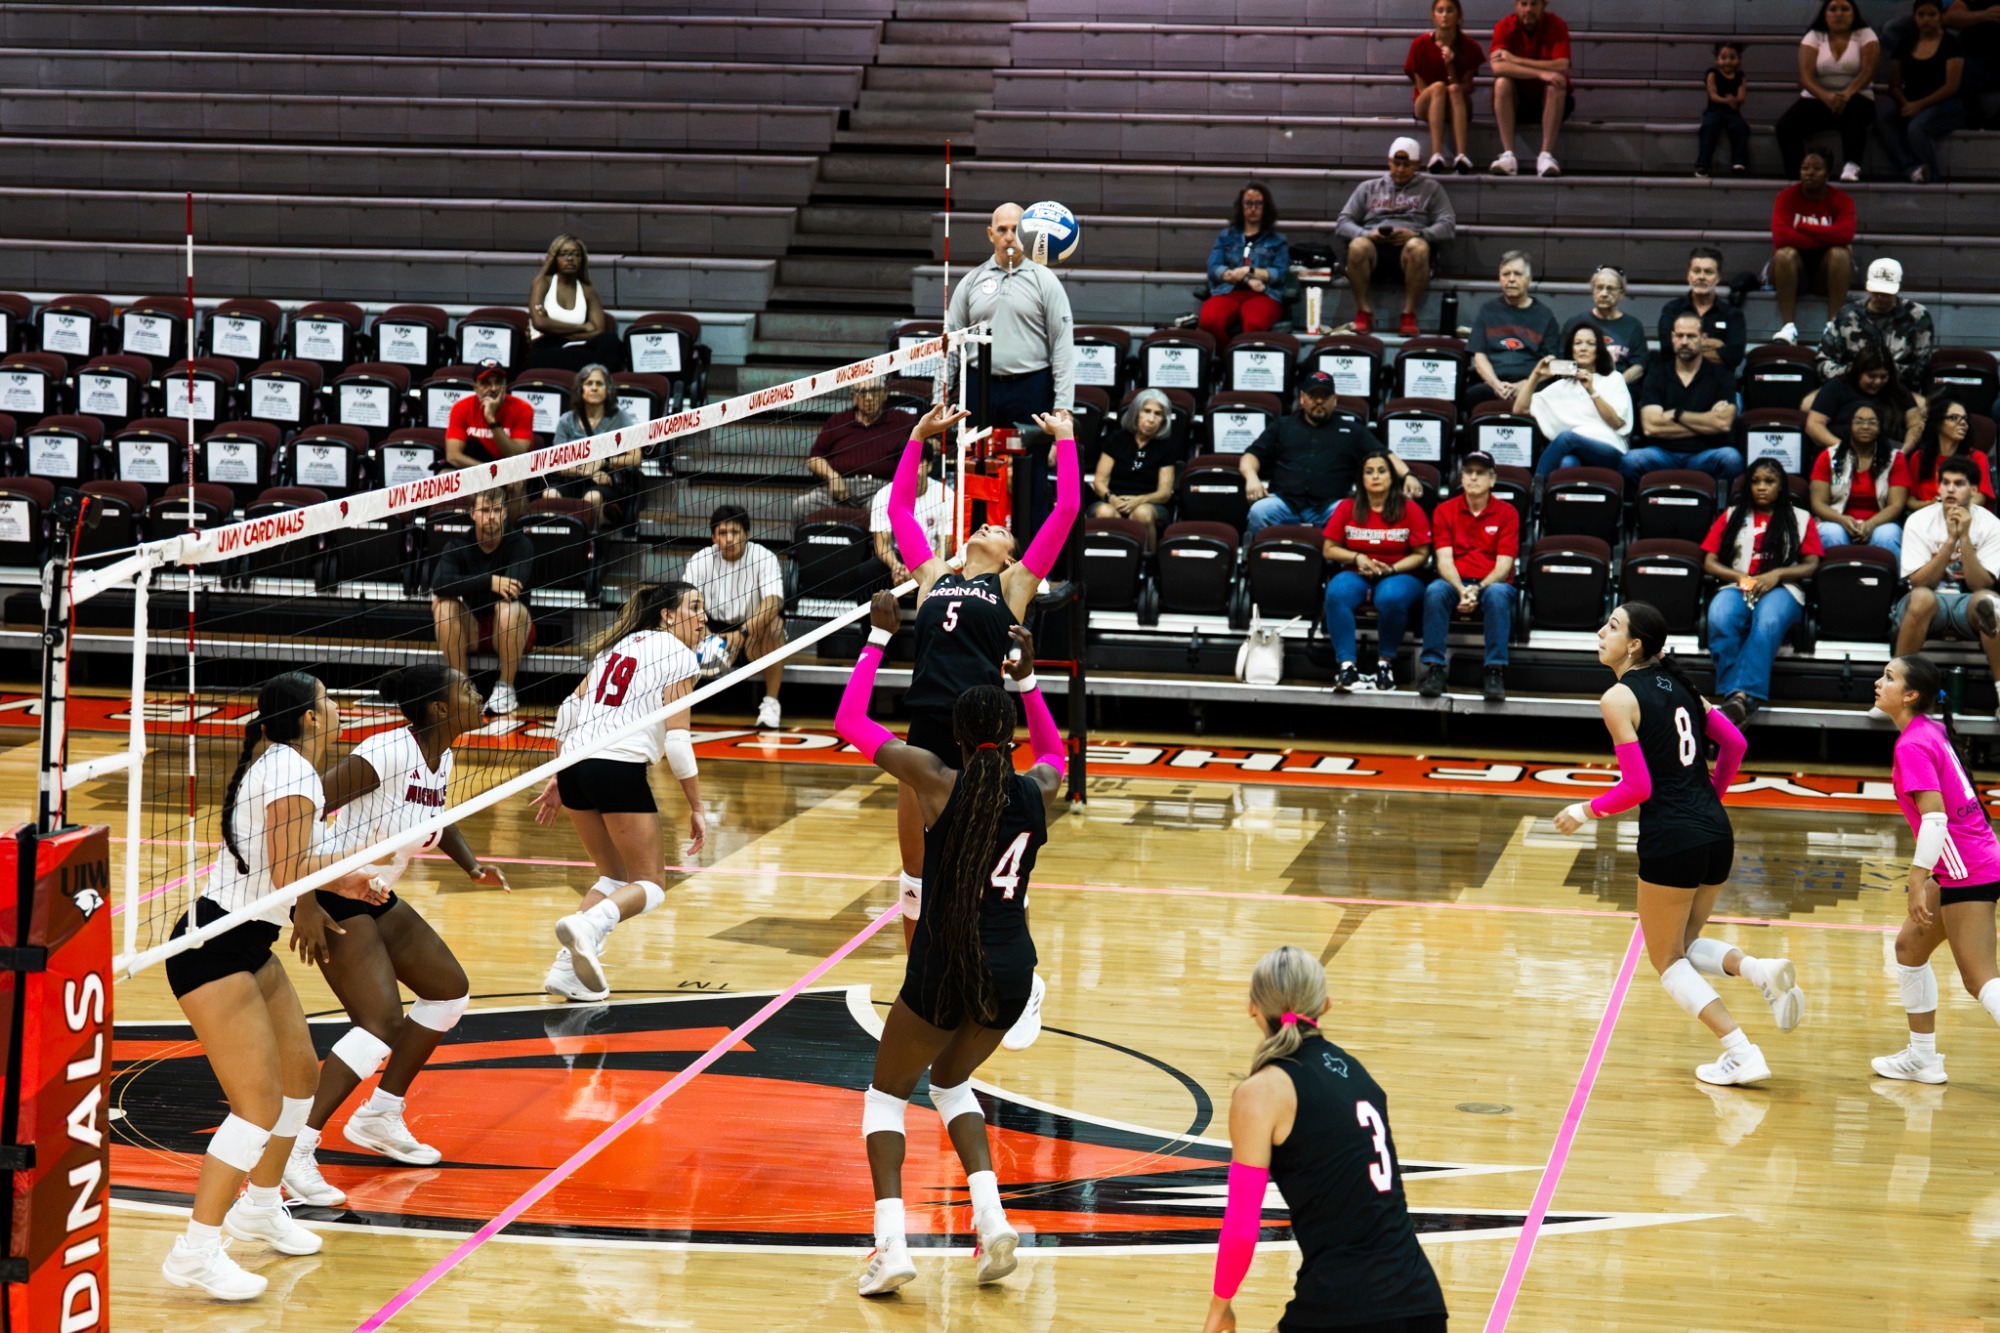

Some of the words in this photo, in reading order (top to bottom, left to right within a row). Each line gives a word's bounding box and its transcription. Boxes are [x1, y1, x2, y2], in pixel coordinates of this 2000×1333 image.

[762, 384, 795, 407] CARDINALS
[663, 410, 701, 436] CARDINALS
[549, 440, 591, 467] CARDINALS
[410, 473, 461, 503] CARDINALS
[243, 511, 305, 546] CARDINALS
[942, 601, 962, 632] 5
[594, 652, 637, 707] 19
[1674, 706, 1697, 767] 8
[1078, 745, 1384, 777] THE
[60, 861, 109, 897] UIW
[990, 831, 1032, 899] 4
[1355, 1099, 1393, 1192] 3
